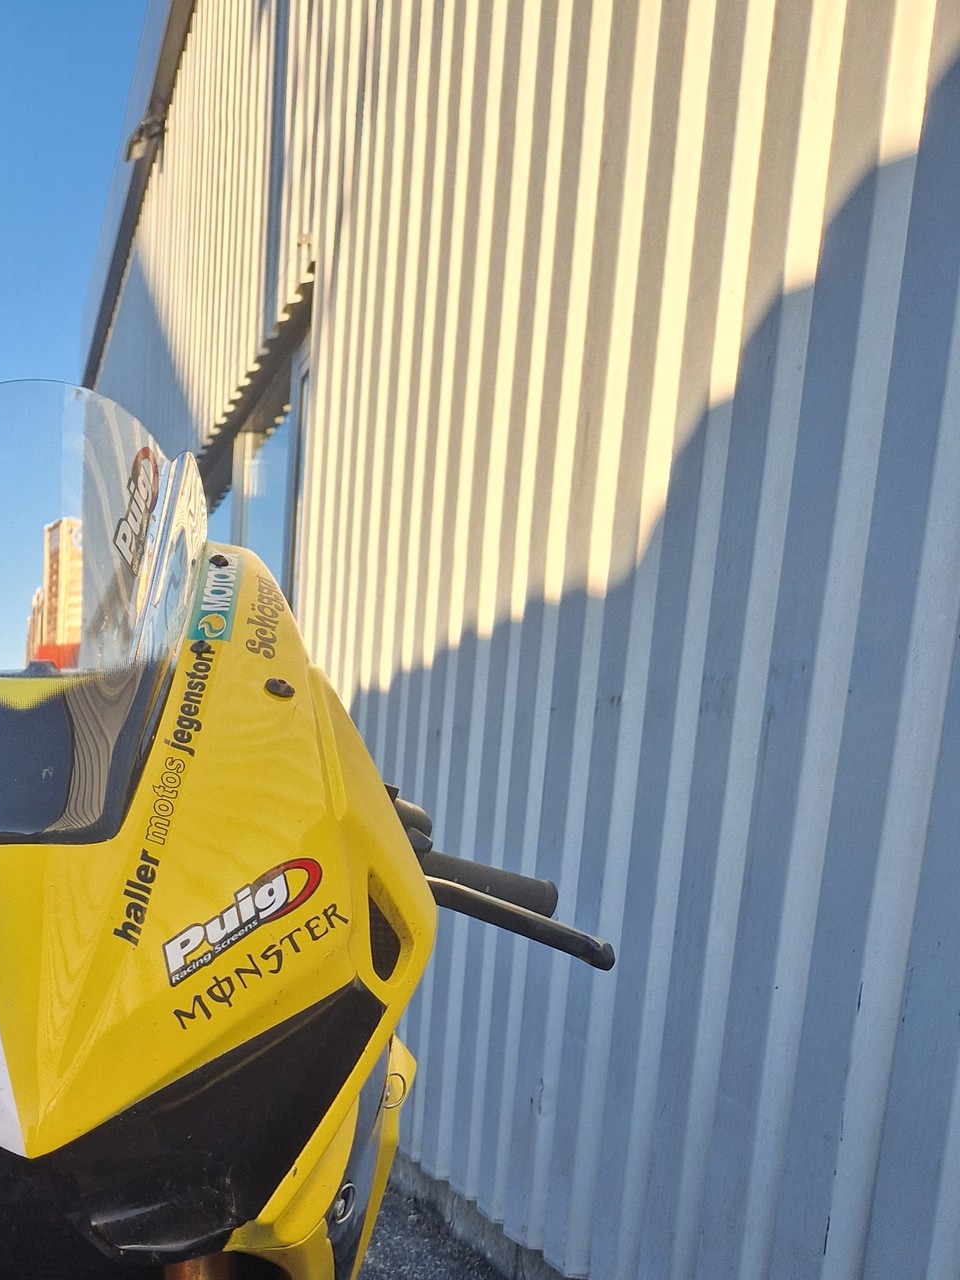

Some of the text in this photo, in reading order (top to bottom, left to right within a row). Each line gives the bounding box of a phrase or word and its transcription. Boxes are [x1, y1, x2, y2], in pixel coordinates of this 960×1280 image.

[114, 464, 153, 567] Puig
[113, 848, 160, 946] haller
[146, 757, 185, 845] motos
[164, 873, 289, 975] Puig
[172, 919, 258, 984] Racing Screens
